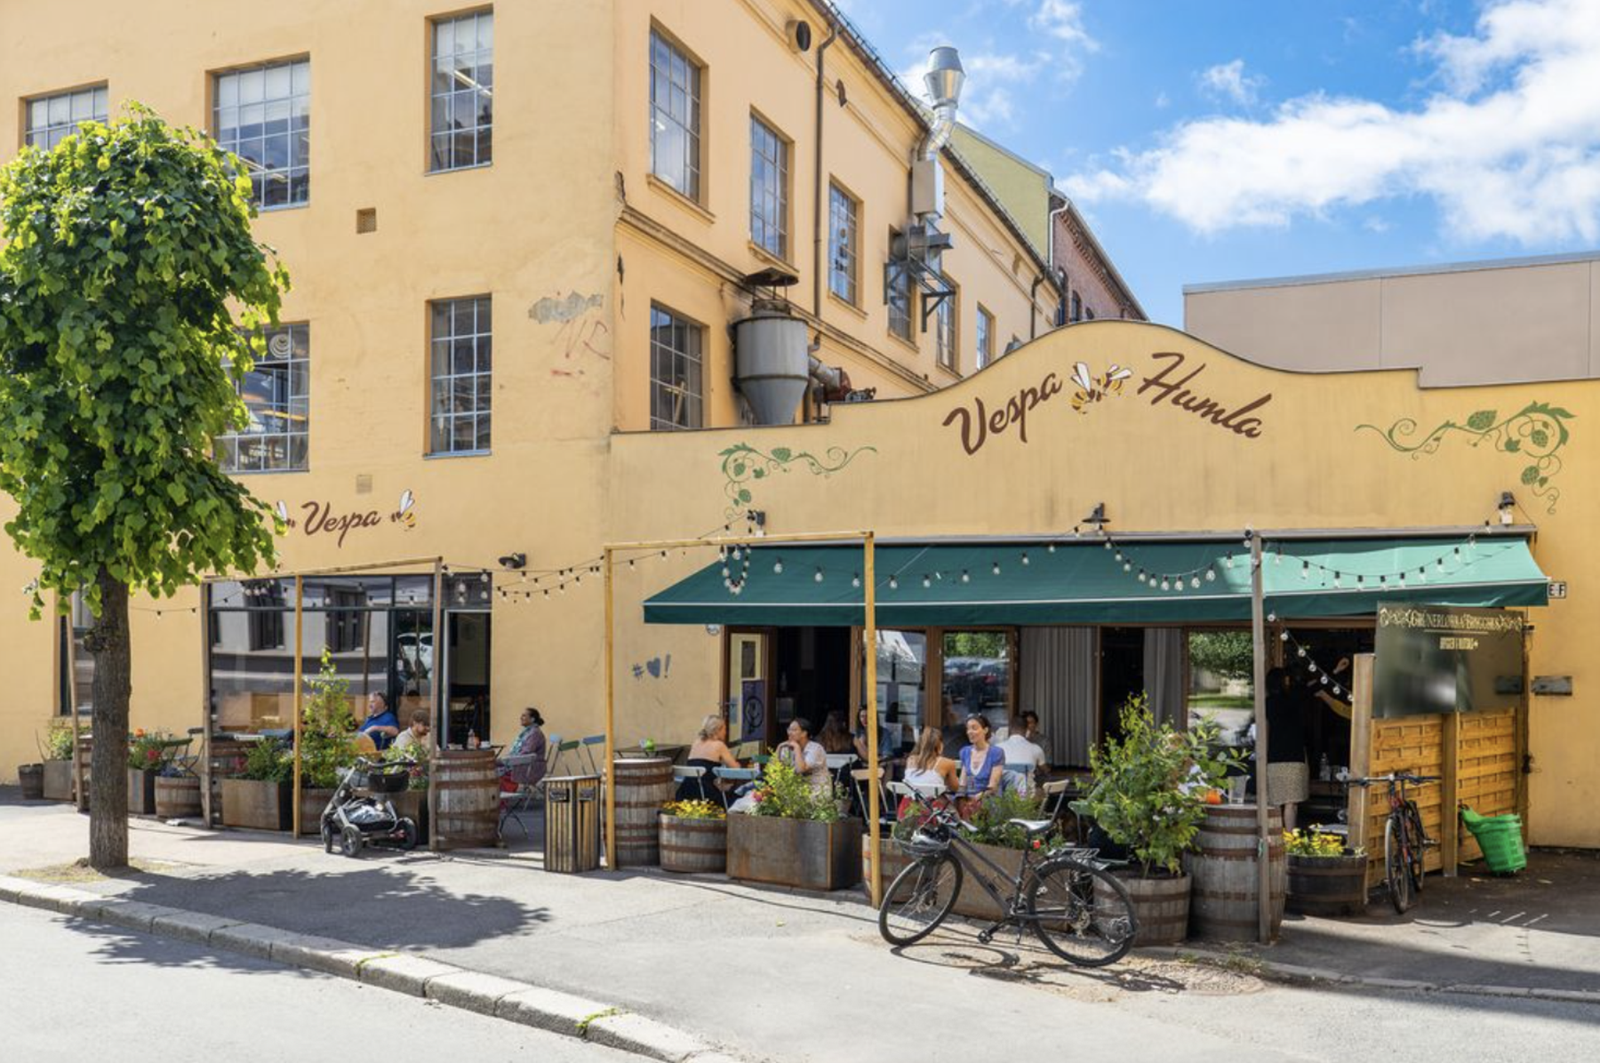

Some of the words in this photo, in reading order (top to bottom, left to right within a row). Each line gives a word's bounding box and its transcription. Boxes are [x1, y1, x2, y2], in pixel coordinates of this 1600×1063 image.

[942, 372, 1063, 455] Vespa
[1137, 352, 1272, 439] Humla
[301, 501, 382, 548] Vespa
